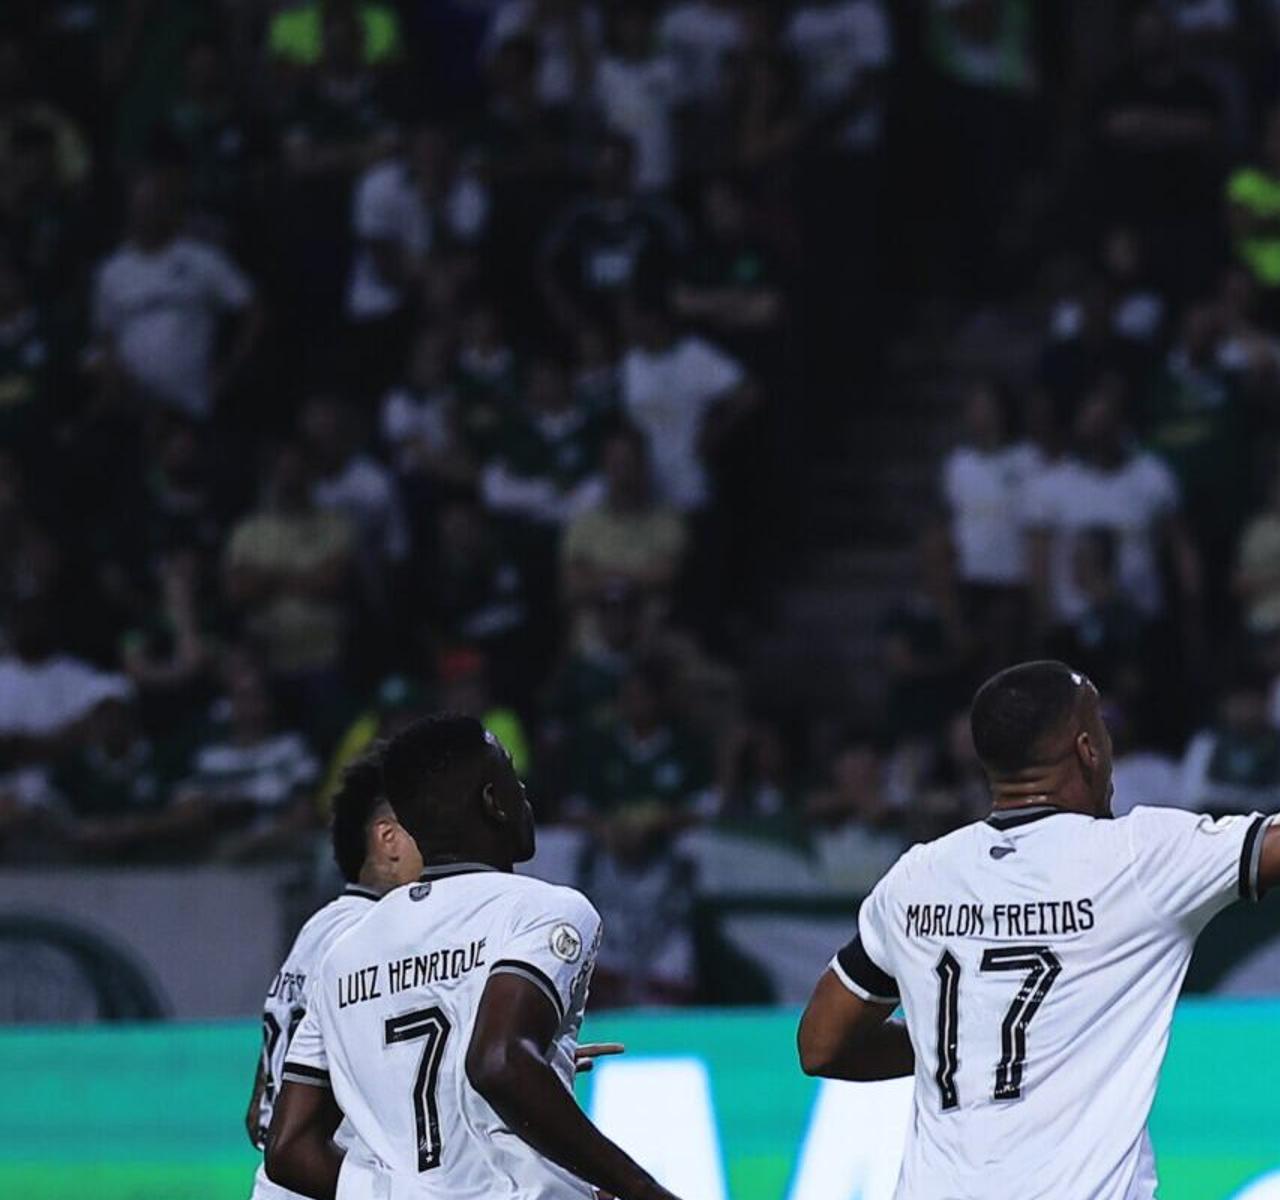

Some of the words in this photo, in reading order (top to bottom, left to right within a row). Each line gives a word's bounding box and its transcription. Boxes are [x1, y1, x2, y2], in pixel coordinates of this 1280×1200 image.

[338, 965, 382, 1009] LUIZ
[388, 936, 487, 995] HENRIQUE
[905, 903, 984, 938] MARLON
[993, 898, 1095, 937] FREITAS
[935, 944, 1063, 1111] 17
[384, 1005, 452, 1173] 7
